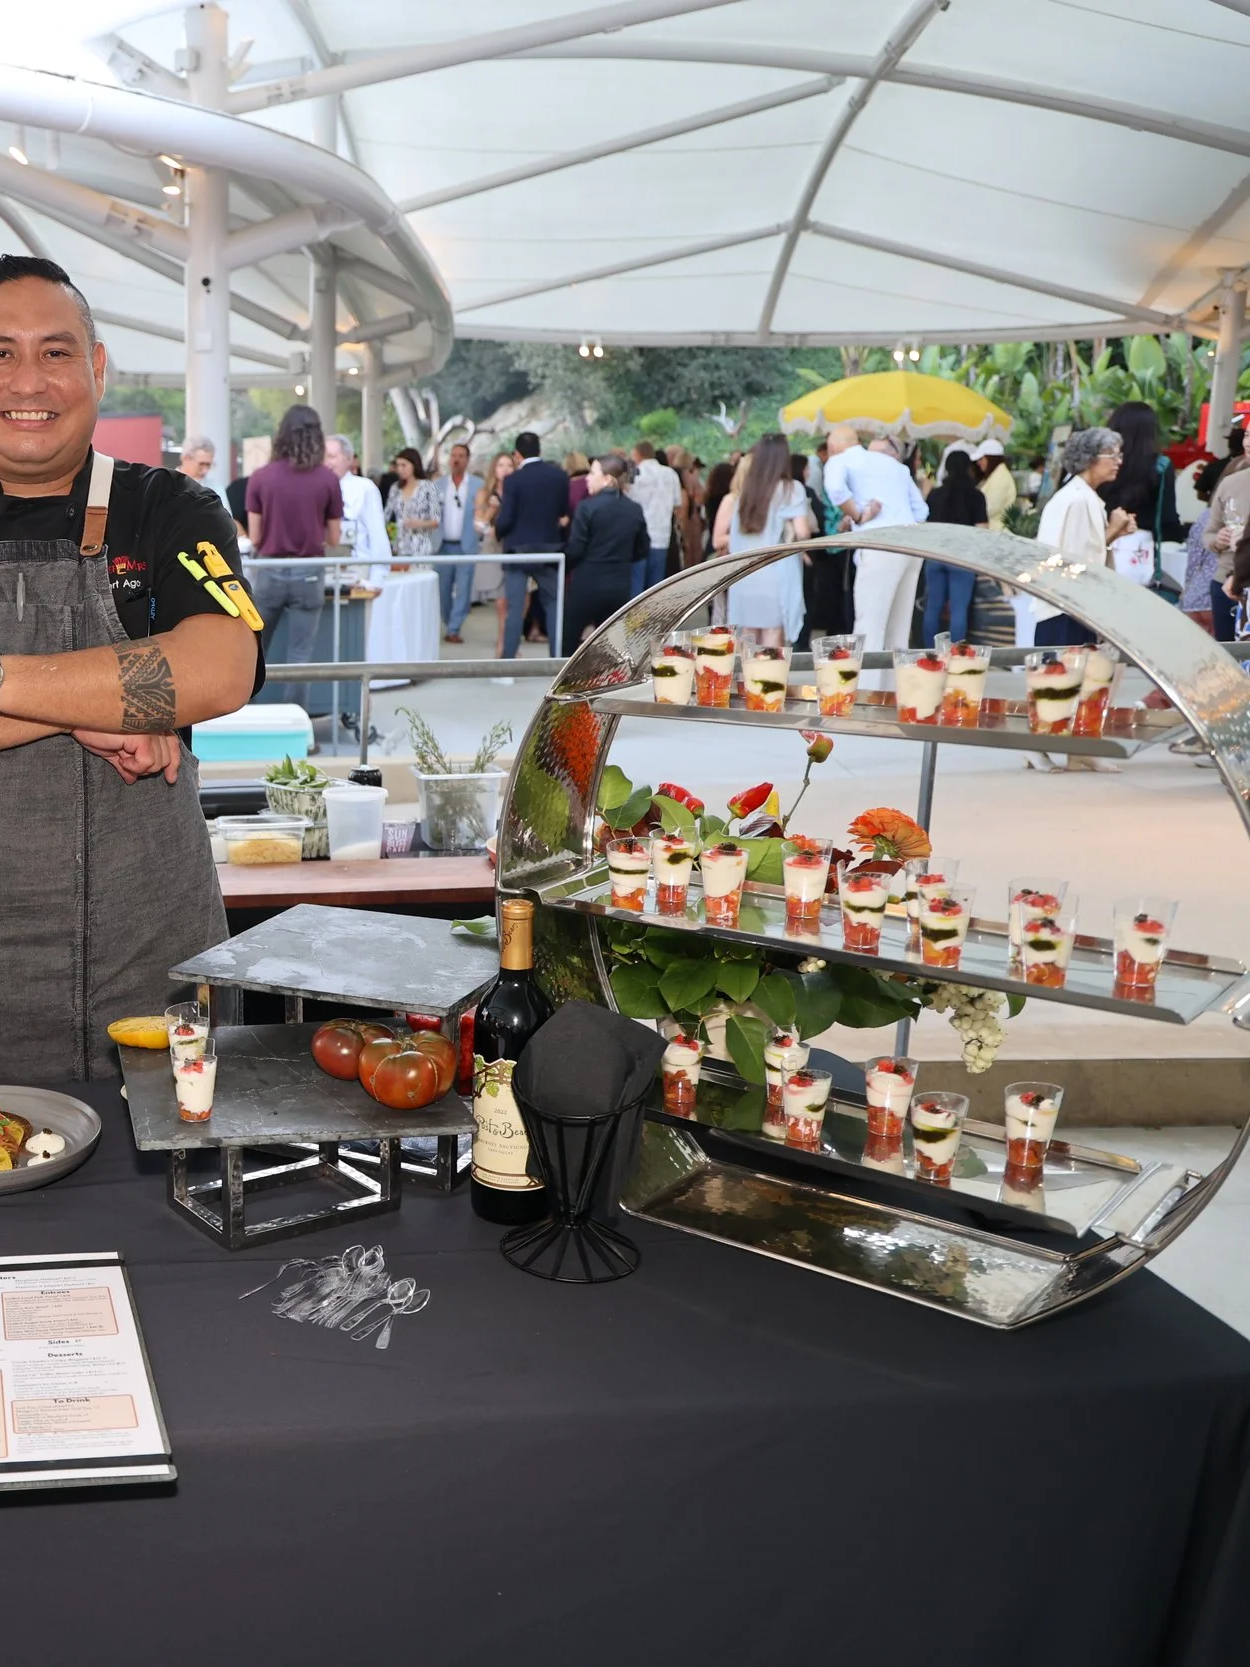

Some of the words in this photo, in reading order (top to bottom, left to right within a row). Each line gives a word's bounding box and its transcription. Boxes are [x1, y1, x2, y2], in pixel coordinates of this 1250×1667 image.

[388, 828, 408, 840] SUN
[500, 1121, 527, 1139] Bea
[499, 1142, 528, 1150] SAUVIGNO
[66, 1396, 91, 1404] Drink
